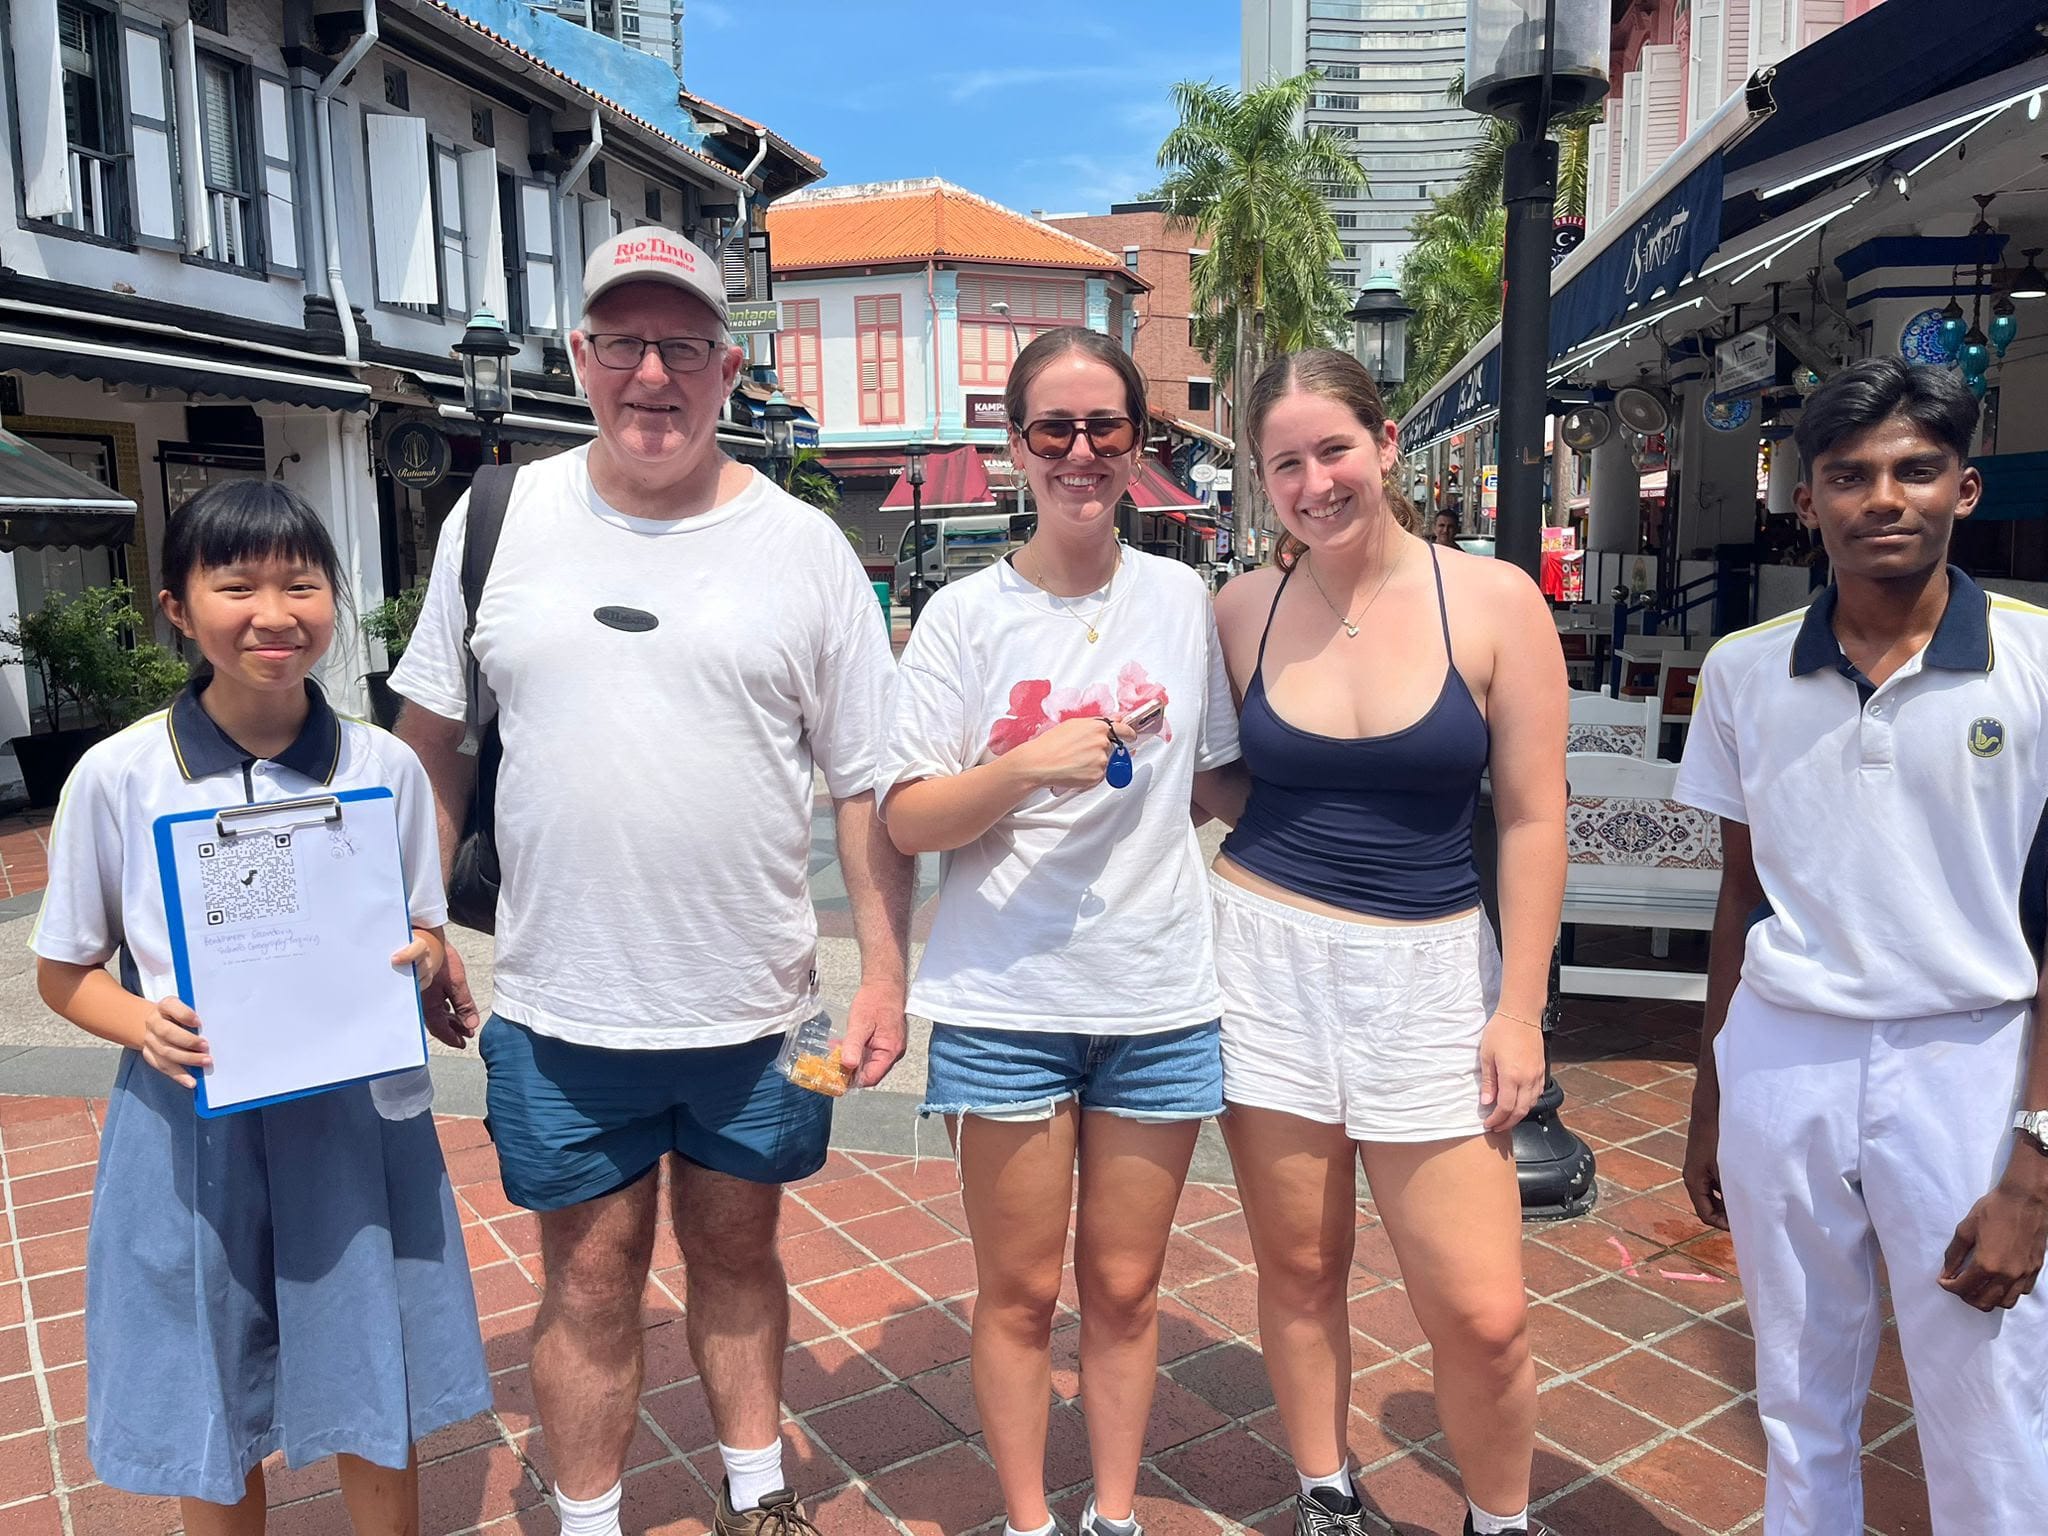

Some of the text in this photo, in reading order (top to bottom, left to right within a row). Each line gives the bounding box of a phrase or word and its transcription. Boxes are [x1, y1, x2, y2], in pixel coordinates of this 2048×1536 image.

[1554, 216, 1584, 226] GRILL
[616, 238, 695, 264] Rio Tinto
